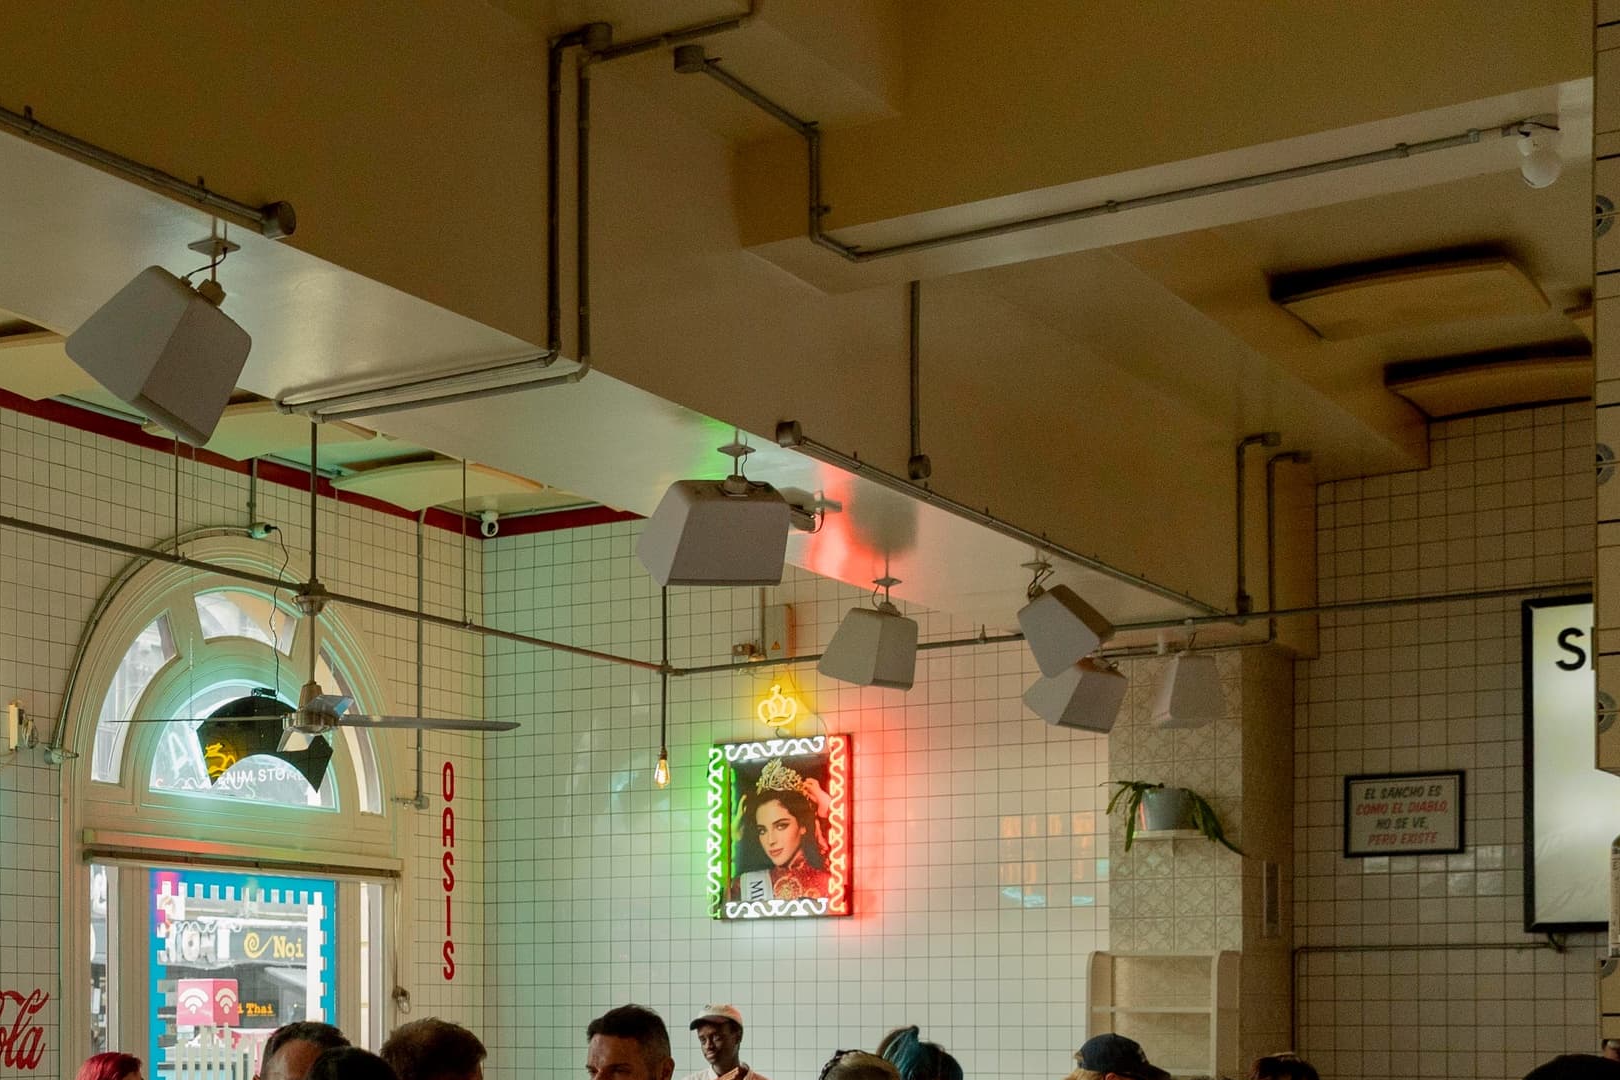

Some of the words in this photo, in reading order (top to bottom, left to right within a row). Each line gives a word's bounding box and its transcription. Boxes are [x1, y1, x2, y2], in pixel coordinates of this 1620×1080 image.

[1555, 627, 1595, 671] S
[1364, 788, 1376, 800] EL
[1380, 785, 1425, 800] SANCHO
[1428, 784, 1443, 797] ES
[1356, 803, 1389, 816] COMO
[1391, 802, 1404, 814] EL
[1376, 818, 1392, 829] NO
[1394, 817, 1409, 829] SE
[1368, 833, 1397, 846] PERO
[1401, 831, 1438, 844] EXISTE
[442, 761, 455, 981] OASIS
[272, 935, 305, 959] Noi
[245, 1002, 274, 1015] Thai
